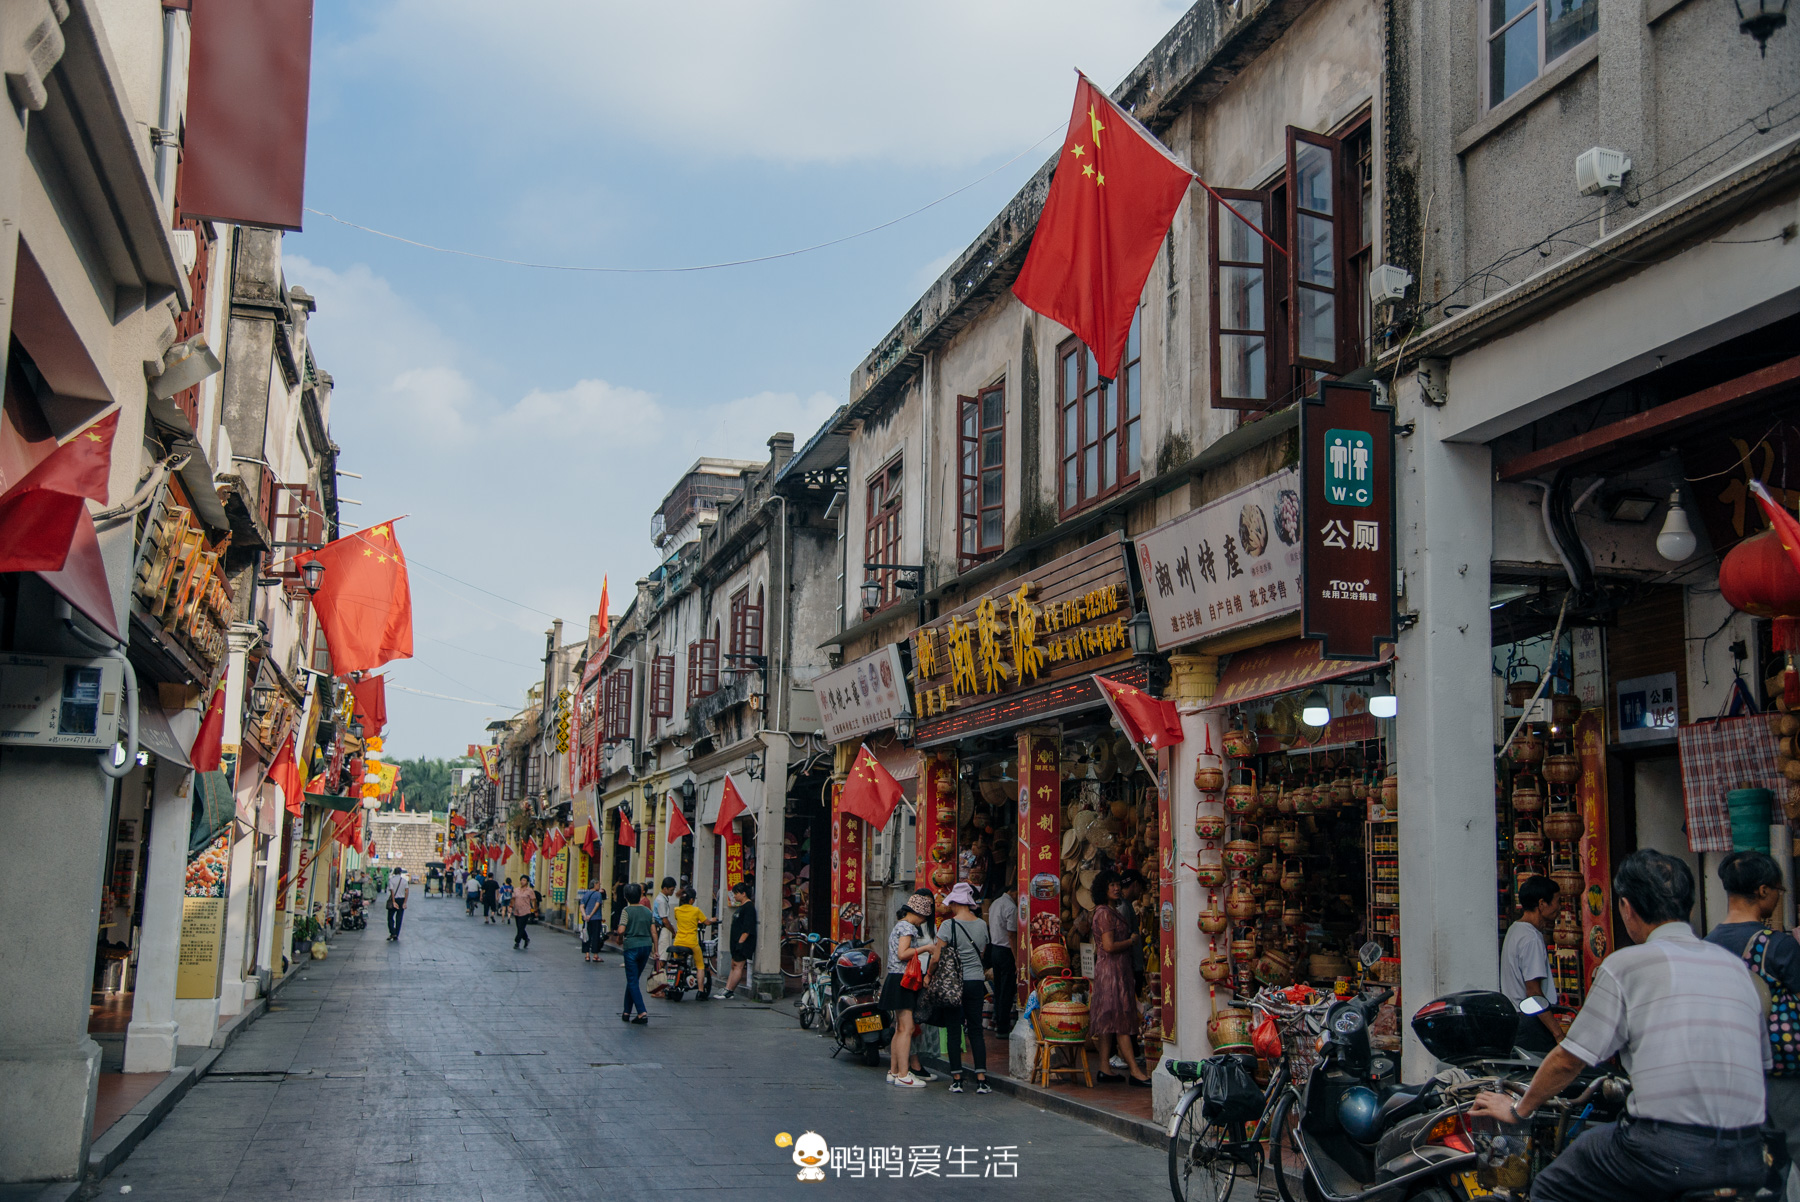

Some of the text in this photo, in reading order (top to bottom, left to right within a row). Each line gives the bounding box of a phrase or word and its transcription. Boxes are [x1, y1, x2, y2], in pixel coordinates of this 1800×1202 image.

[1320, 519, 1379, 551] 公厕
[1208, 594, 1244, 622] 自产自销
[1249, 580, 1288, 609] 批发零售
[1322, 590, 1378, 602] 统用卫浴捐建
[1651, 706, 1675, 726] WC
[1037, 784, 1054, 861] 竹制品
[1583, 770, 1599, 867] 潮州三宝
[727, 842, 742, 887] 咸水粿
